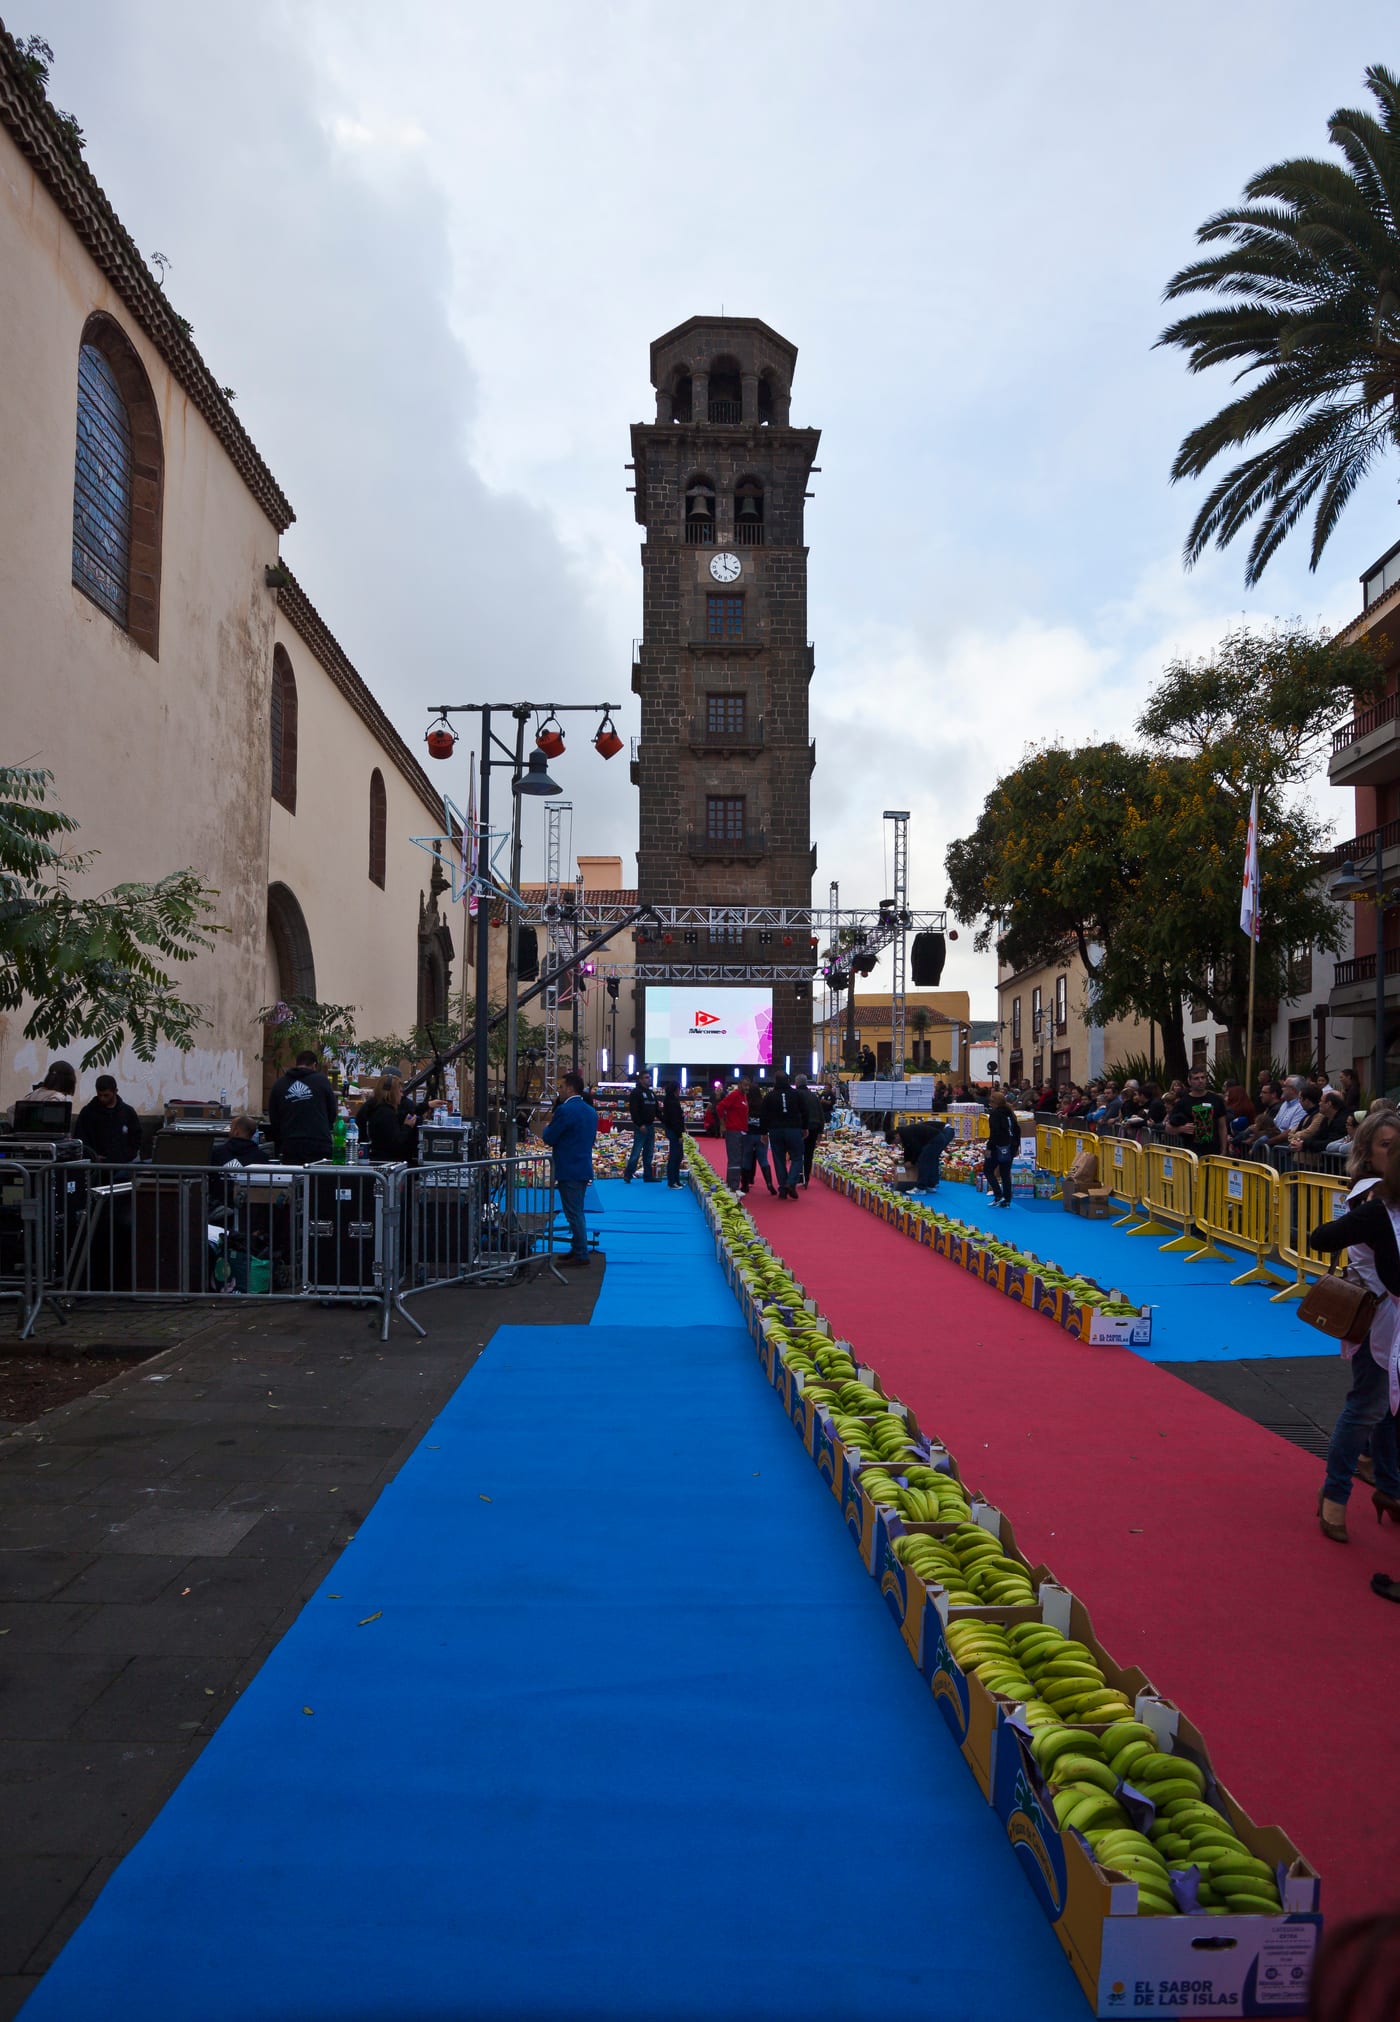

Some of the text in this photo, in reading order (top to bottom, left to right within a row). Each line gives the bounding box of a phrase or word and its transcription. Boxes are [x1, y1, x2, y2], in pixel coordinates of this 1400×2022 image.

[1135, 1980, 1213, 1993] EL SABOR
[1134, 1993, 1238, 2006] DE LAS ISLAS
